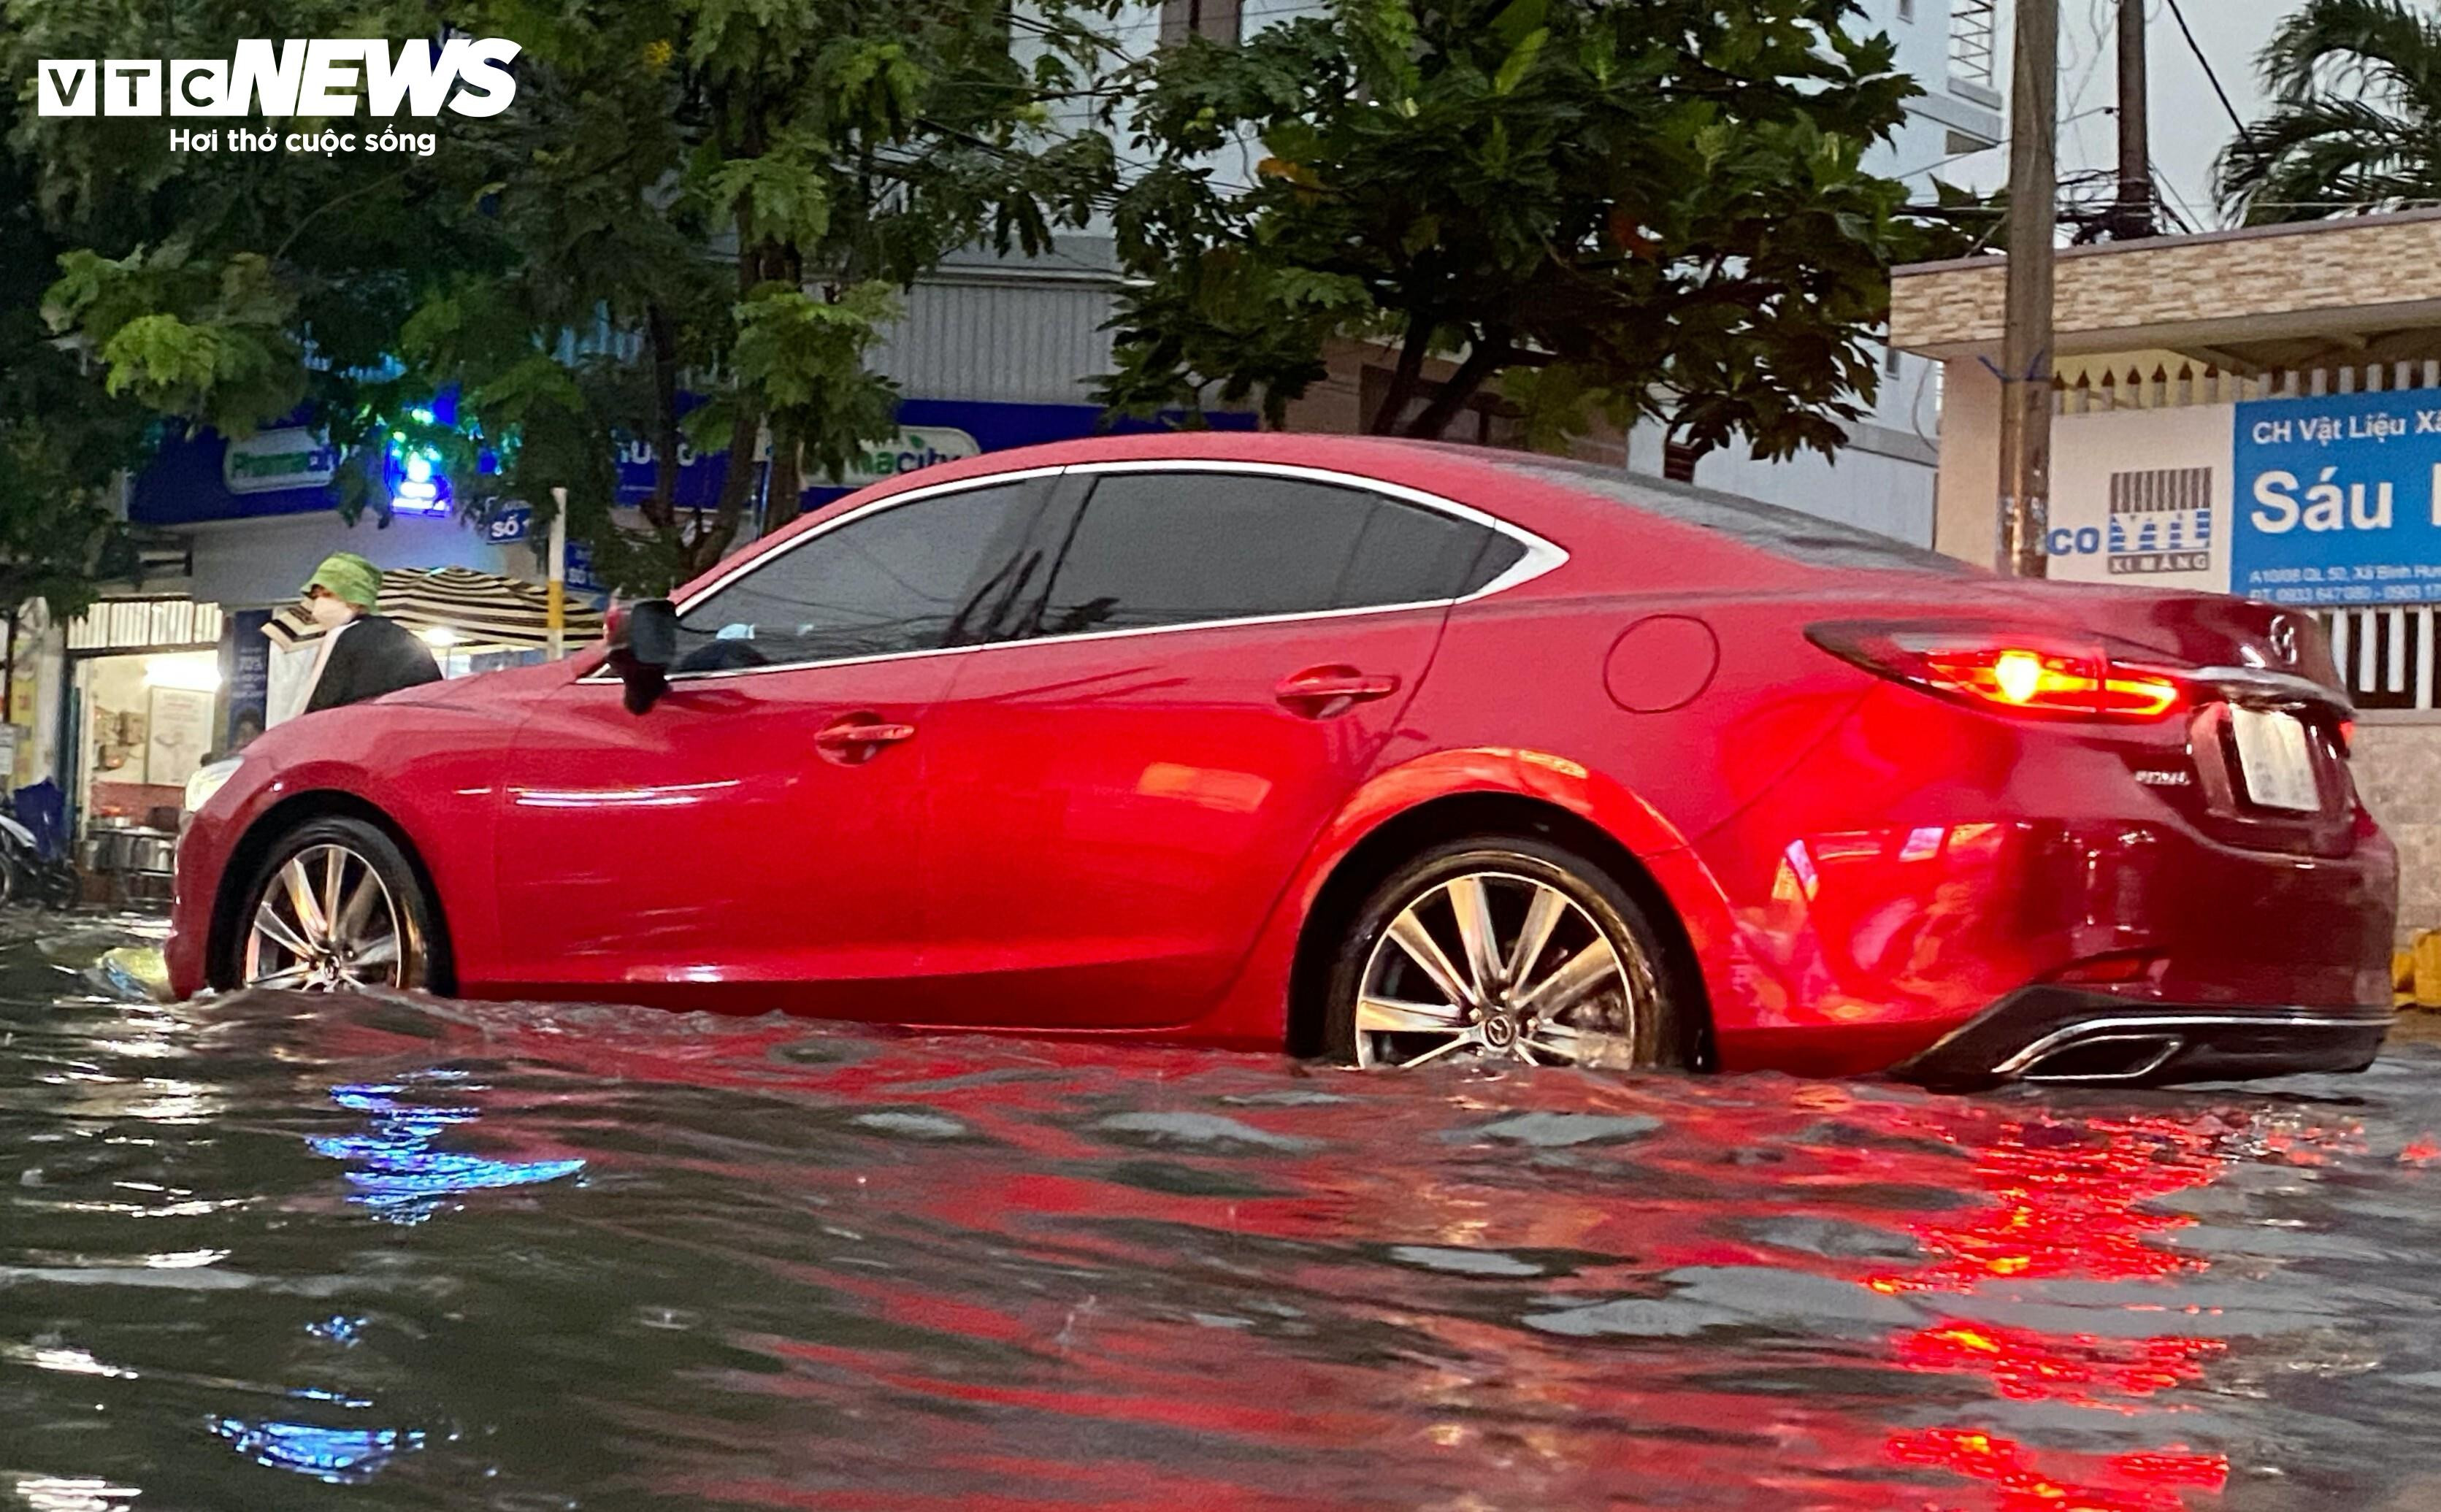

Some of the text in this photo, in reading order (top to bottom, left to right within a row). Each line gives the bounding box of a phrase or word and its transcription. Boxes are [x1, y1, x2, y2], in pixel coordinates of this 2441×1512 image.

[2253, 421, 2292, 445] CH
[2299, 416, 2342, 447] Vật
[2349, 412, 2406, 443] Liệu
[2251, 466, 2394, 534] Sáu
